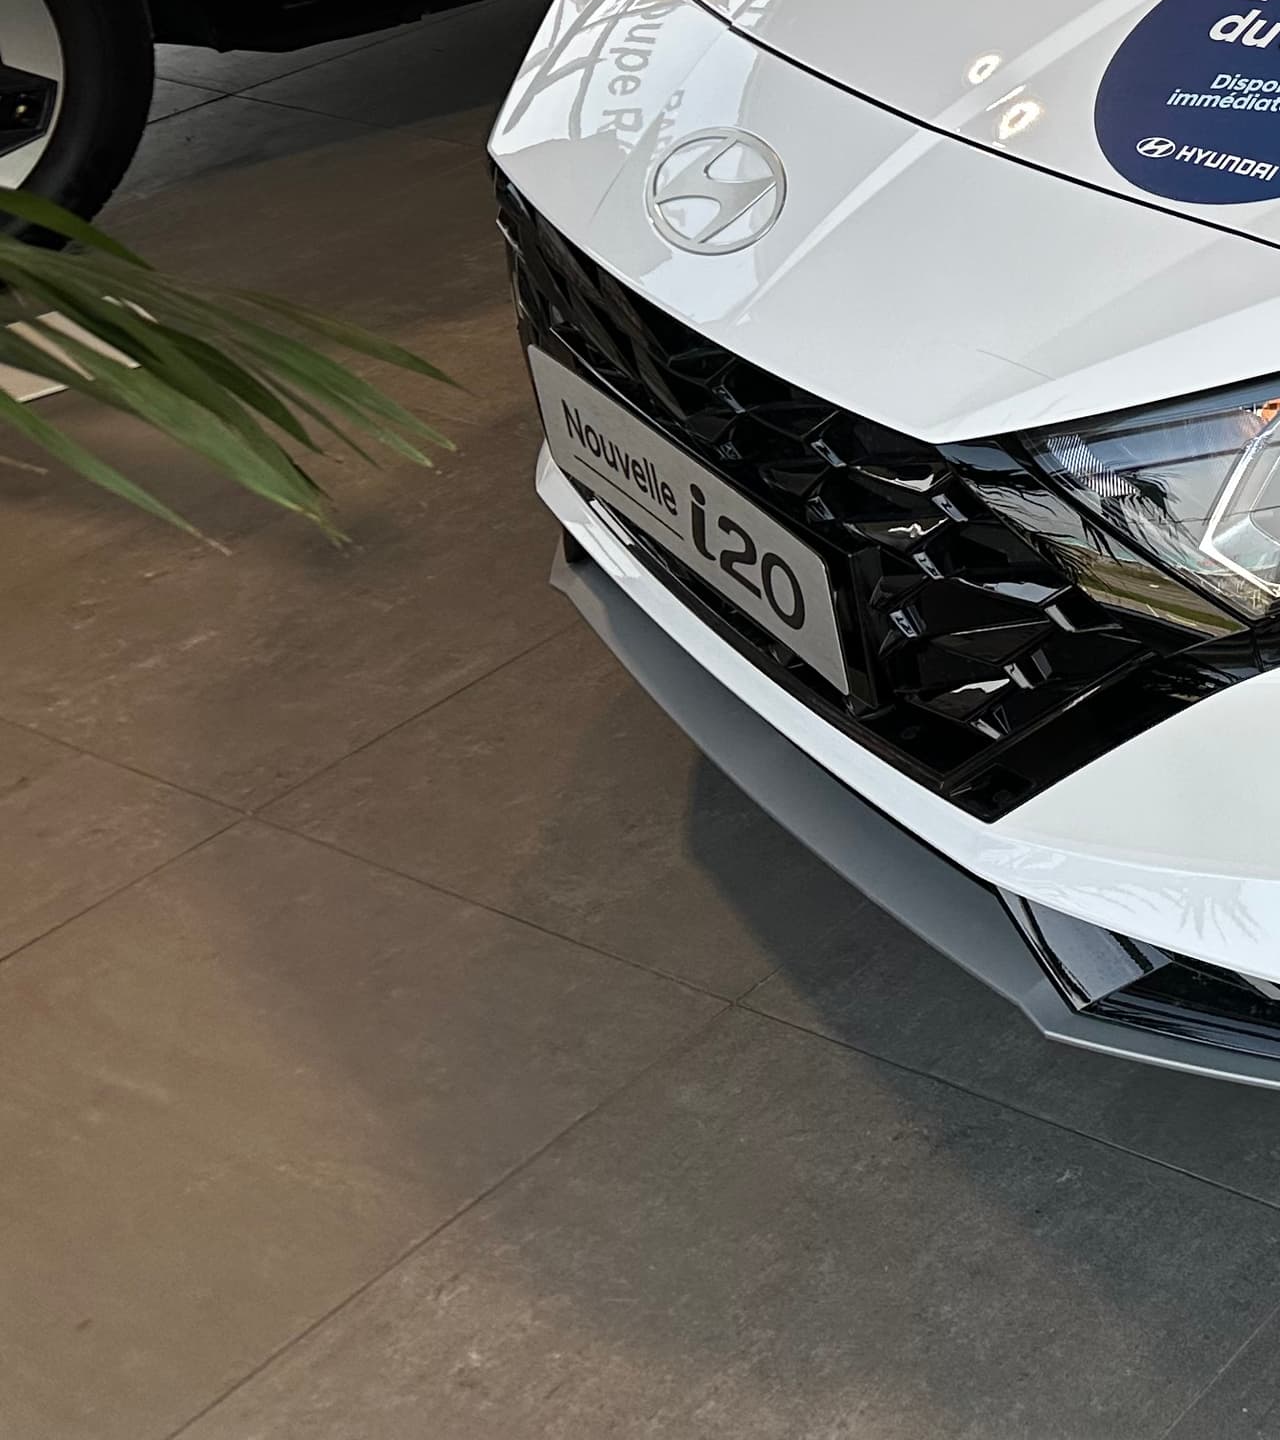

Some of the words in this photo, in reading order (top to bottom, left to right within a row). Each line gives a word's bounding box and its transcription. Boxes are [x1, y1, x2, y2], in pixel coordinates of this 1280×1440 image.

[1175, 144, 1280, 181] HYUNDAI
[561, 398, 678, 516] Nouvelle
[689, 483, 805, 630] i20
